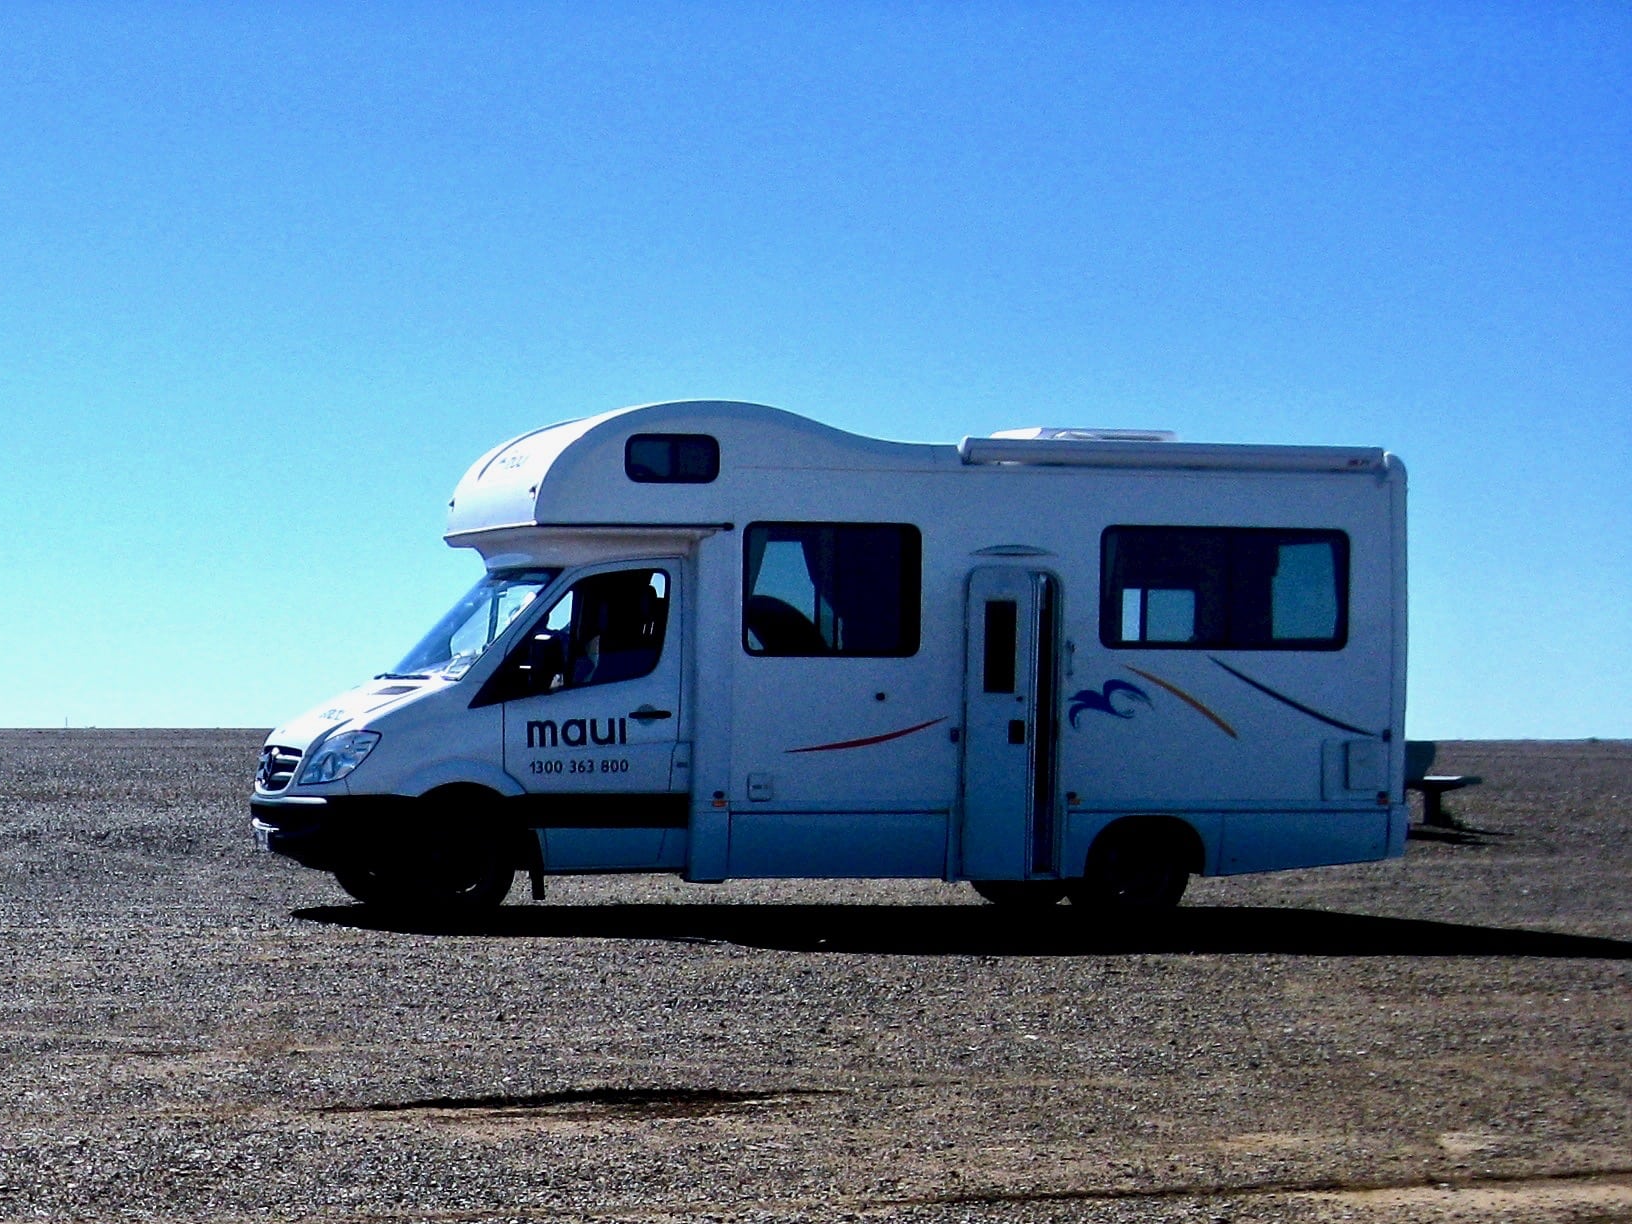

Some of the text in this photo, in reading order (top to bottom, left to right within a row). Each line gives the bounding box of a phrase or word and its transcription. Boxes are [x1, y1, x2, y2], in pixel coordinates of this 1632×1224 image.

[526, 717, 627, 748] maui
[528, 758, 629, 774] 1300 363 800
